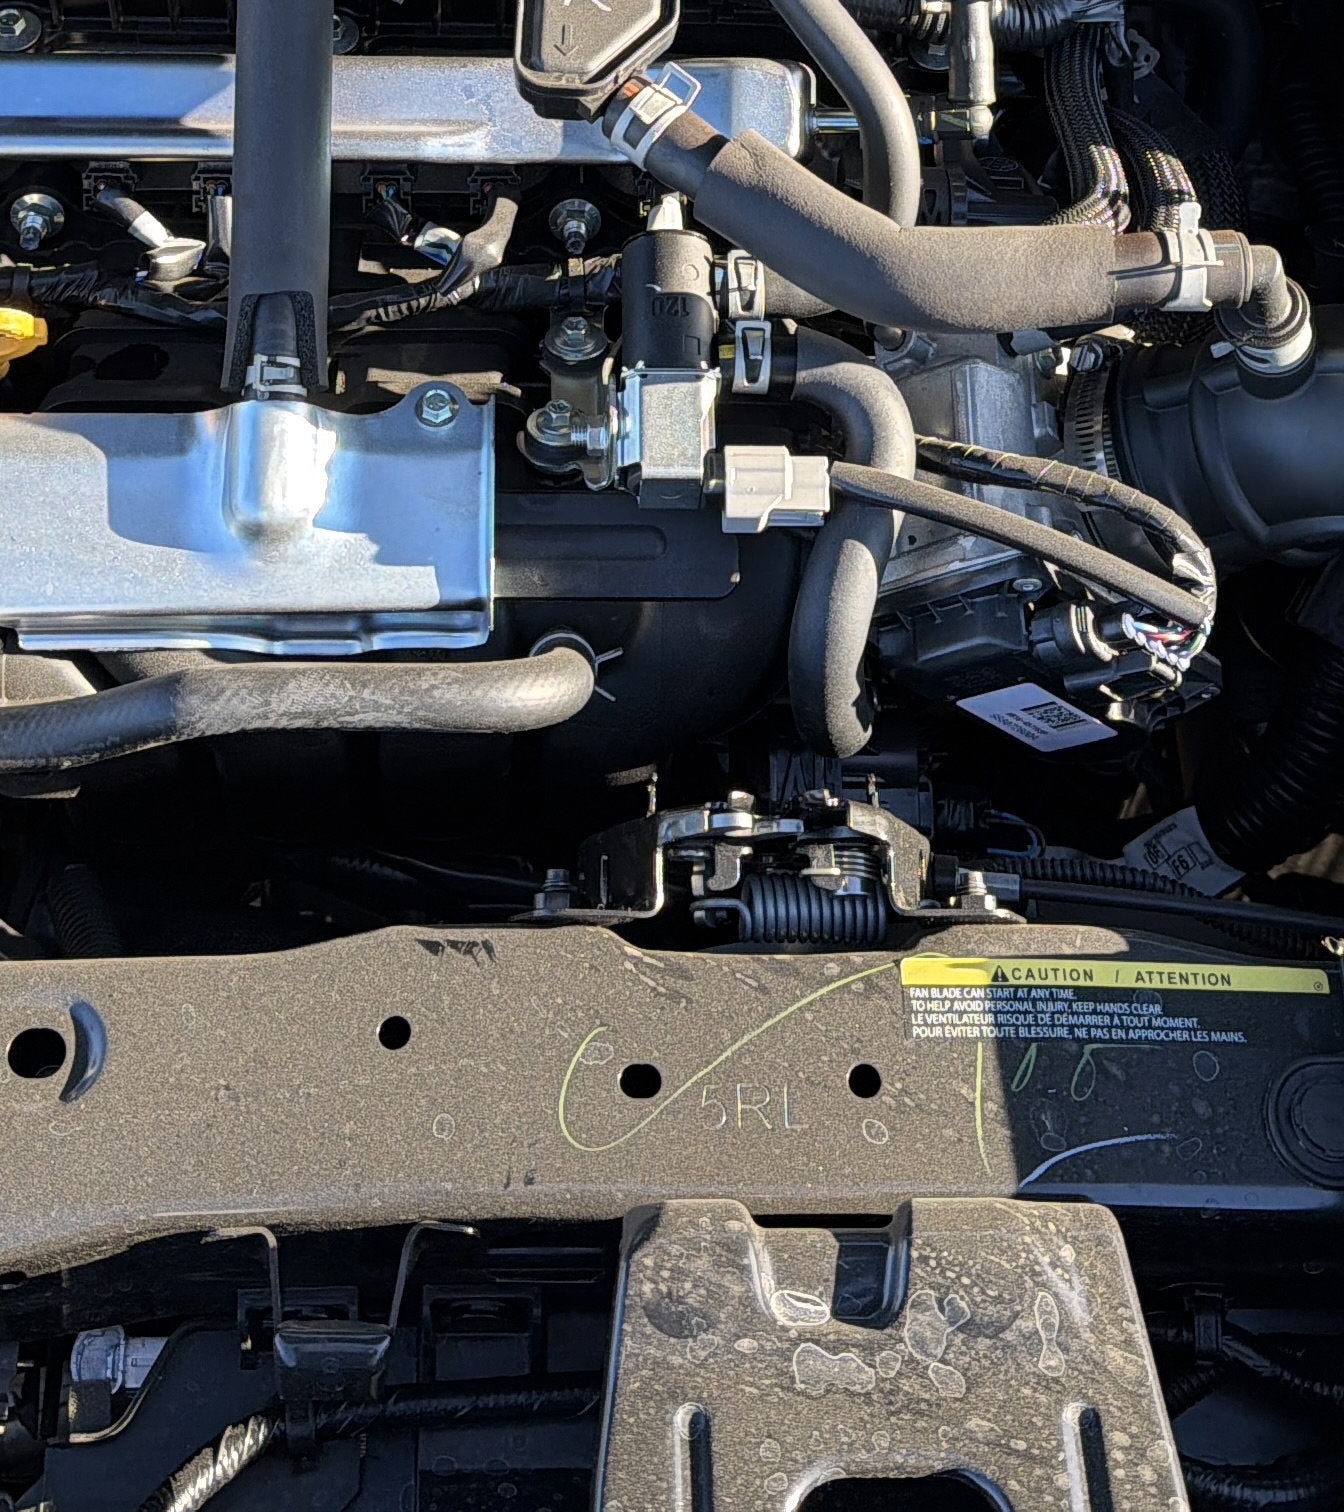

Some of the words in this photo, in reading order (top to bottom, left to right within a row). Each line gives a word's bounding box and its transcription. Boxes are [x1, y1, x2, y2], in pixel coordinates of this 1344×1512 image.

[1011, 967, 1095, 982] CAUTION
[1134, 970, 1232, 987] ATTENTION
[910, 987, 929, 999] FAN
[931, 987, 962, 999] BLADE
[963, 987, 985, 999] CAN
[986, 987, 1014, 999] START
[1016, 988, 1030, 999] AT
[1030, 988, 1051, 999] ANY
[1051, 988, 1077, 1000] TIME.
[911, 1000, 925, 1012] TO
[927, 1000, 951, 1012] HELP
[952, 1000, 984, 1012] AVOID
[984, 1000, 1034, 1013] PERSONAL
[1072, 1002, 1095, 1013] KEEP
[1097, 1002, 1130, 1014] HANDS
[1131, 1003, 1164, 1015] CLEAR.
[912, 1013, 925, 1025] LE
[925, 1013, 996, 1025] VENTILATEUR
[997, 1013, 1035, 1026] RISQUE
[1054, 1011, 1110, 1026] DÉMARRER
[1112, 1013, 1121, 1026] À
[1121, 1015, 1150, 1027] TOUT
[1151, 1016, 1201, 1028] MOMENT.
[912, 1026, 943, 1039] POUR
[945, 1024, 981, 1039] ÉVITER
[981, 1027, 1016, 1039] TOUTE
[1018, 1027, 1072, 1039] BLESSURE,
[1074, 1027, 1089, 1040] NE
[1090, 1028, 1110, 1040] PAS
[1112, 1028, 1127, 1040] EN
[1128, 1029, 1190, 1041] APPROCHER
[1191, 1030, 1209, 1042] LES
[1210, 1031, 1248, 1043] MAINS.
